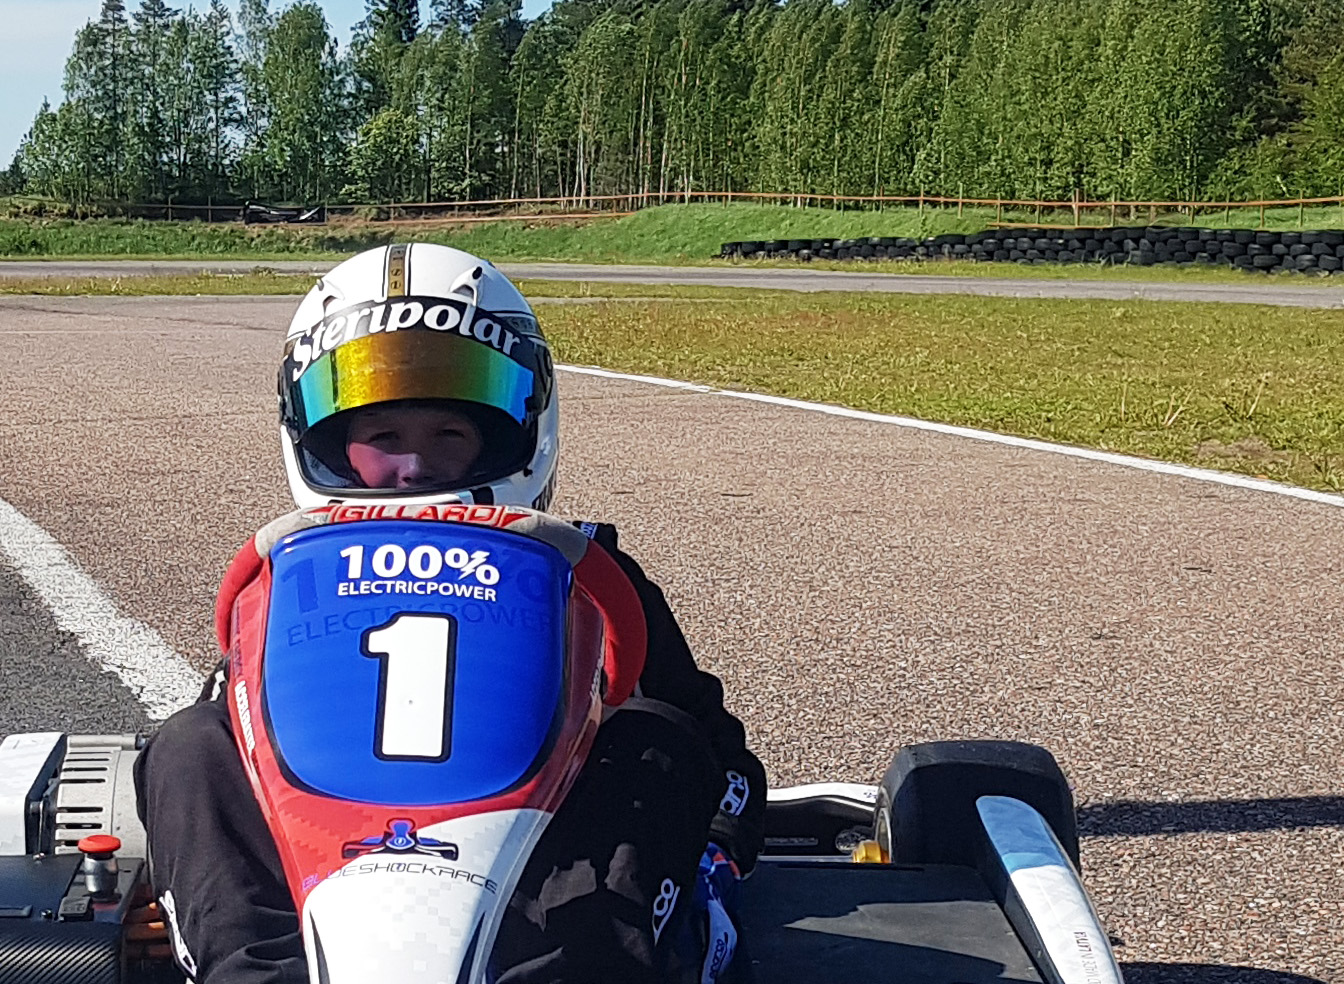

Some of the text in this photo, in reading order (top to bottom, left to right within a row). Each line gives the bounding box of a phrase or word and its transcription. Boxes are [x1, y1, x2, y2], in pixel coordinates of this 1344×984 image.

[339, 543, 500, 586] 100%
[337, 579, 497, 601] ELECTRICPOWER
[364, 613, 454, 759] 1
[302, 861, 499, 895] BLUESHOCKRACE
